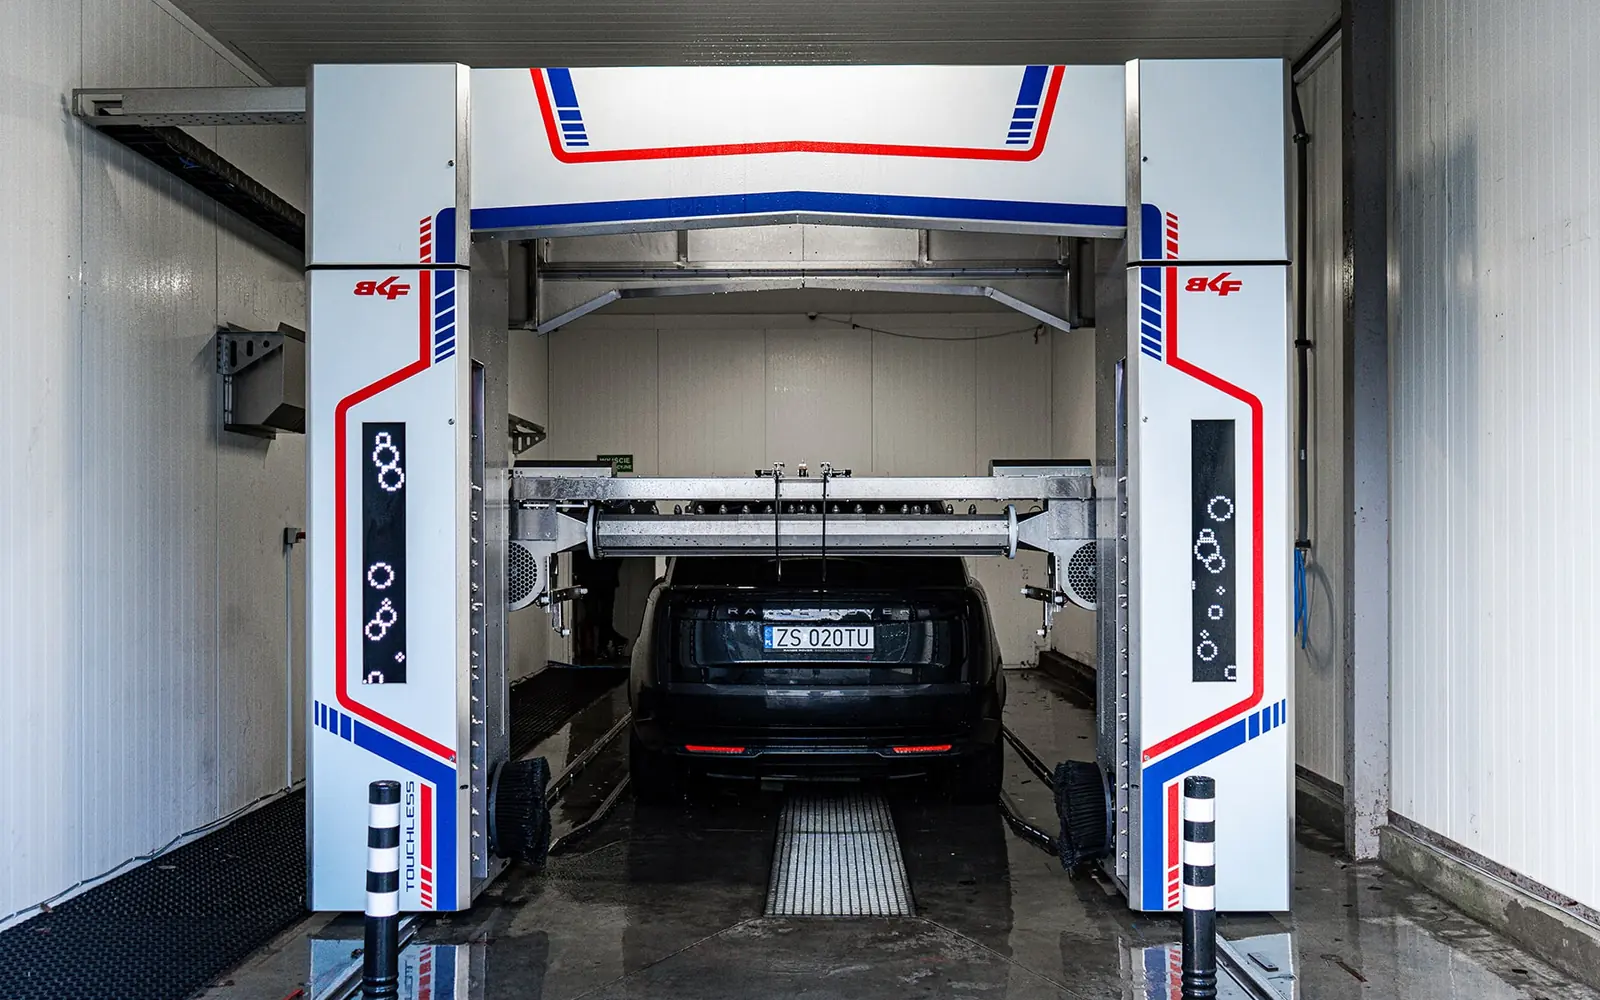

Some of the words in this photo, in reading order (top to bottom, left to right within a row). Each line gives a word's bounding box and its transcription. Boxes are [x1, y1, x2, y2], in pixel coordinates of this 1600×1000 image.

[777, 628, 801, 647] ZS
[809, 628, 869, 647] 020TU
[405, 780, 415, 892] TOUCHLESS
